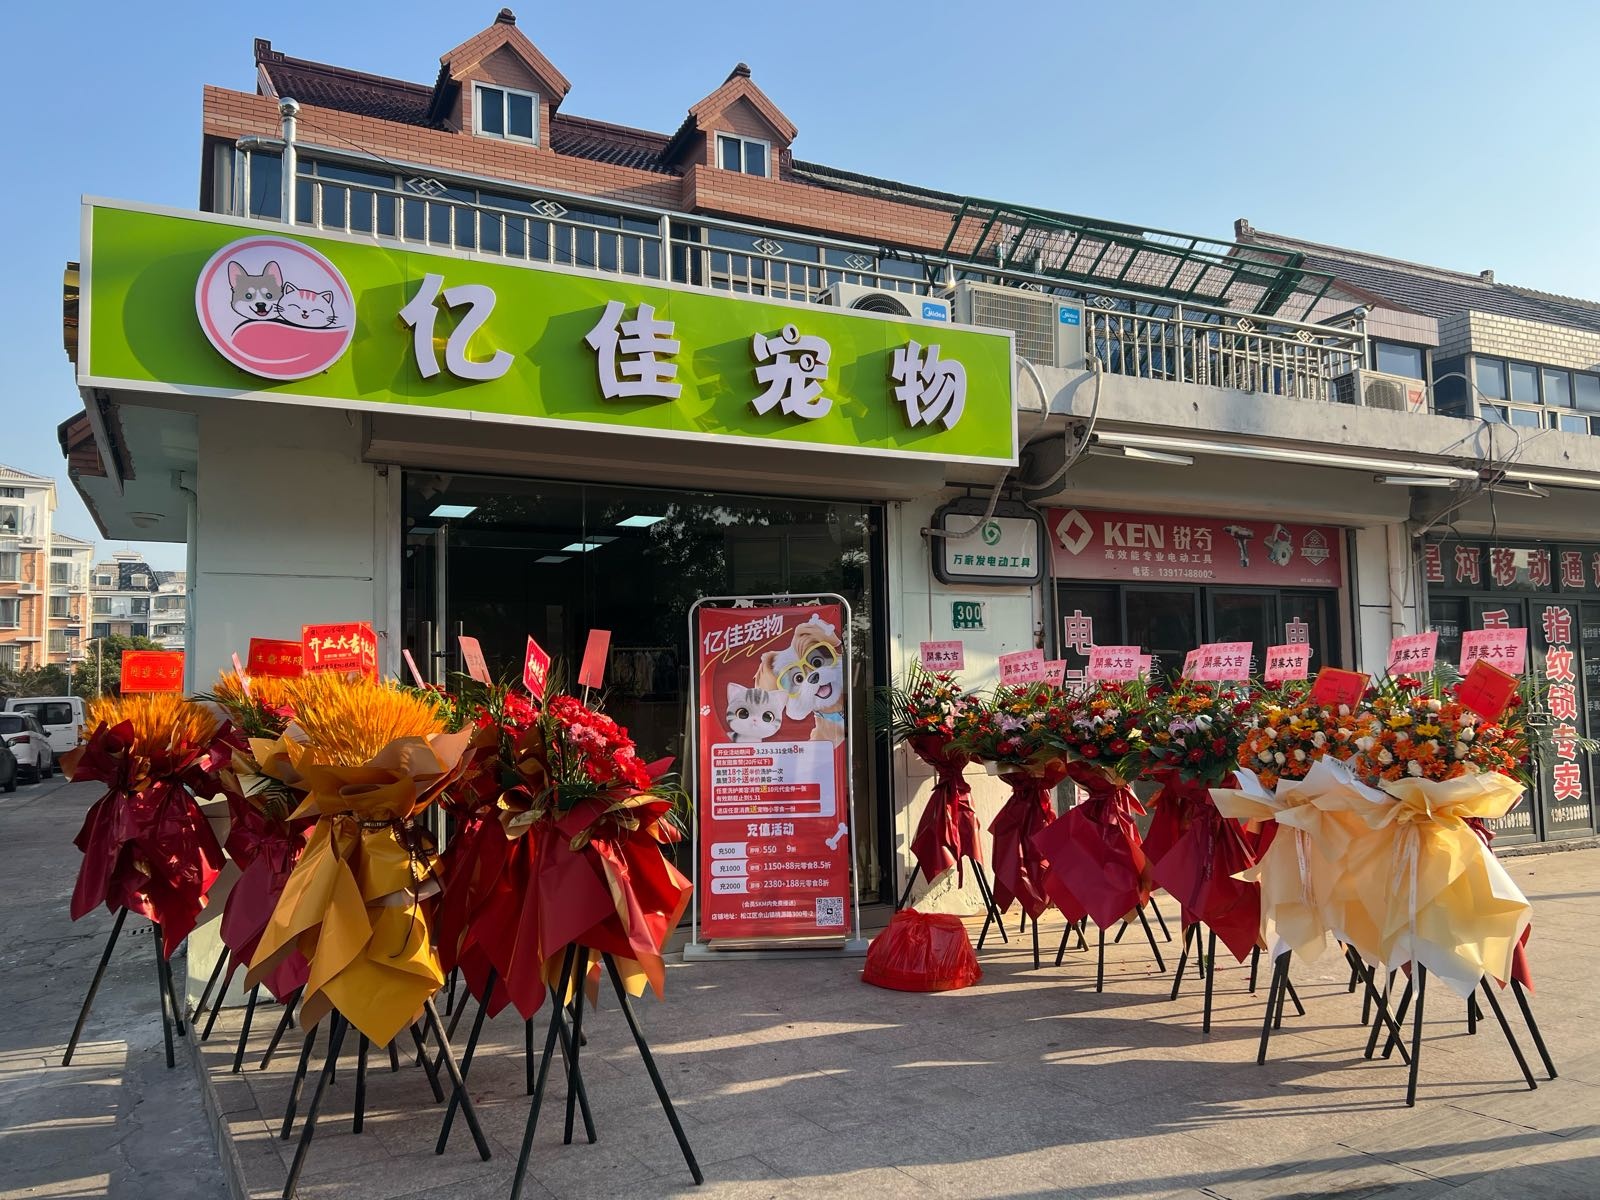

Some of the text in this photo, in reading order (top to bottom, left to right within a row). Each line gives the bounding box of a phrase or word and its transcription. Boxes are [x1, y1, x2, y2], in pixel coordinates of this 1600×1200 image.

[399, 272, 968, 432] 亿佳宠物
[1104, 521, 1213, 551] KEN 锐奇
[953, 554, 1030, 567] 万家发电动工具
[1105, 549, 1213, 564] 高效能专业电动工具
[957, 605, 981, 620] 300
[703, 613, 784, 655] 亿佳宠物
[308, 633, 360, 663] 开业大吉
[1393, 647, 1431, 663] 開業大吉
[1467, 644, 1518, 660] 開業大吉
[1202, 656, 1245, 669] 開業大吉
[1542, 606, 1582, 801] 指纹锁专卖
[747, 823, 795, 837] 充值活动
[718, 847, 736, 855] 充500
[762, 845, 777, 854] 550
[719, 865, 741, 873] 充1000
[719, 882, 741, 890] 充2000
